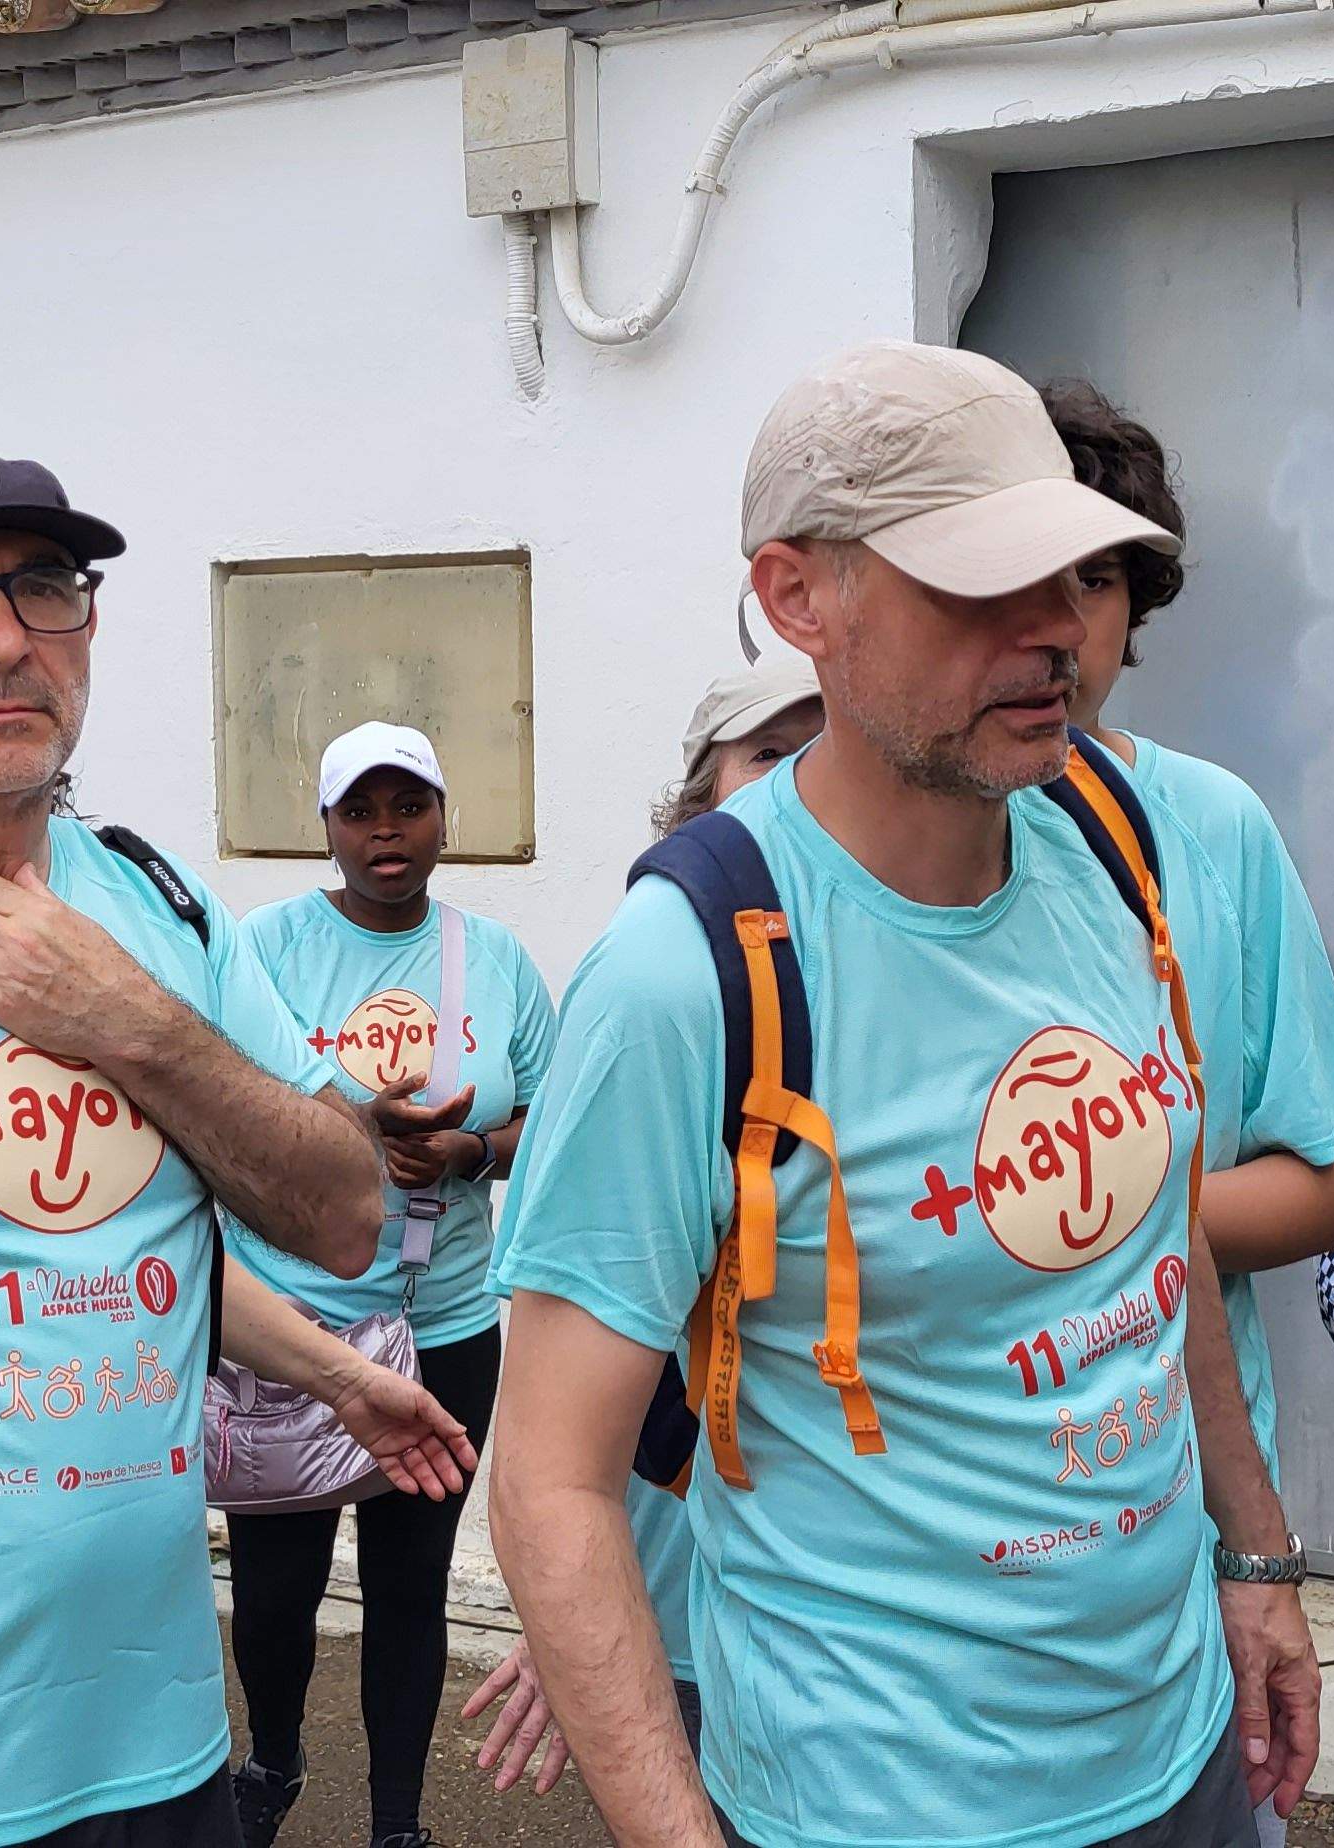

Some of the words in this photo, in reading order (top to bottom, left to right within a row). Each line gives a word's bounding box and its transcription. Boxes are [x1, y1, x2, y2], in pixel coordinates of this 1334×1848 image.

[147, 860, 189, 906] Quechu
[306, 1014, 477, 1070] +mayors
[911, 1025, 1193, 1237] +mayores
[36, 1264, 131, 1302] Marcha
[41, 1302, 88, 1318] ASPACE
[91, 1296, 134, 1313] HUESCA
[109, 1311, 136, 1323] 2023
[1063, 1290, 1153, 1354] Marcha
[1078, 1336, 1116, 1371] ASPACE
[1119, 1314, 1157, 1347] HUESCA
[1132, 1329, 1159, 1350] 2023
[84, 1470, 113, 1482] hoya
[1009, 1519, 1104, 1558] ASPACE
